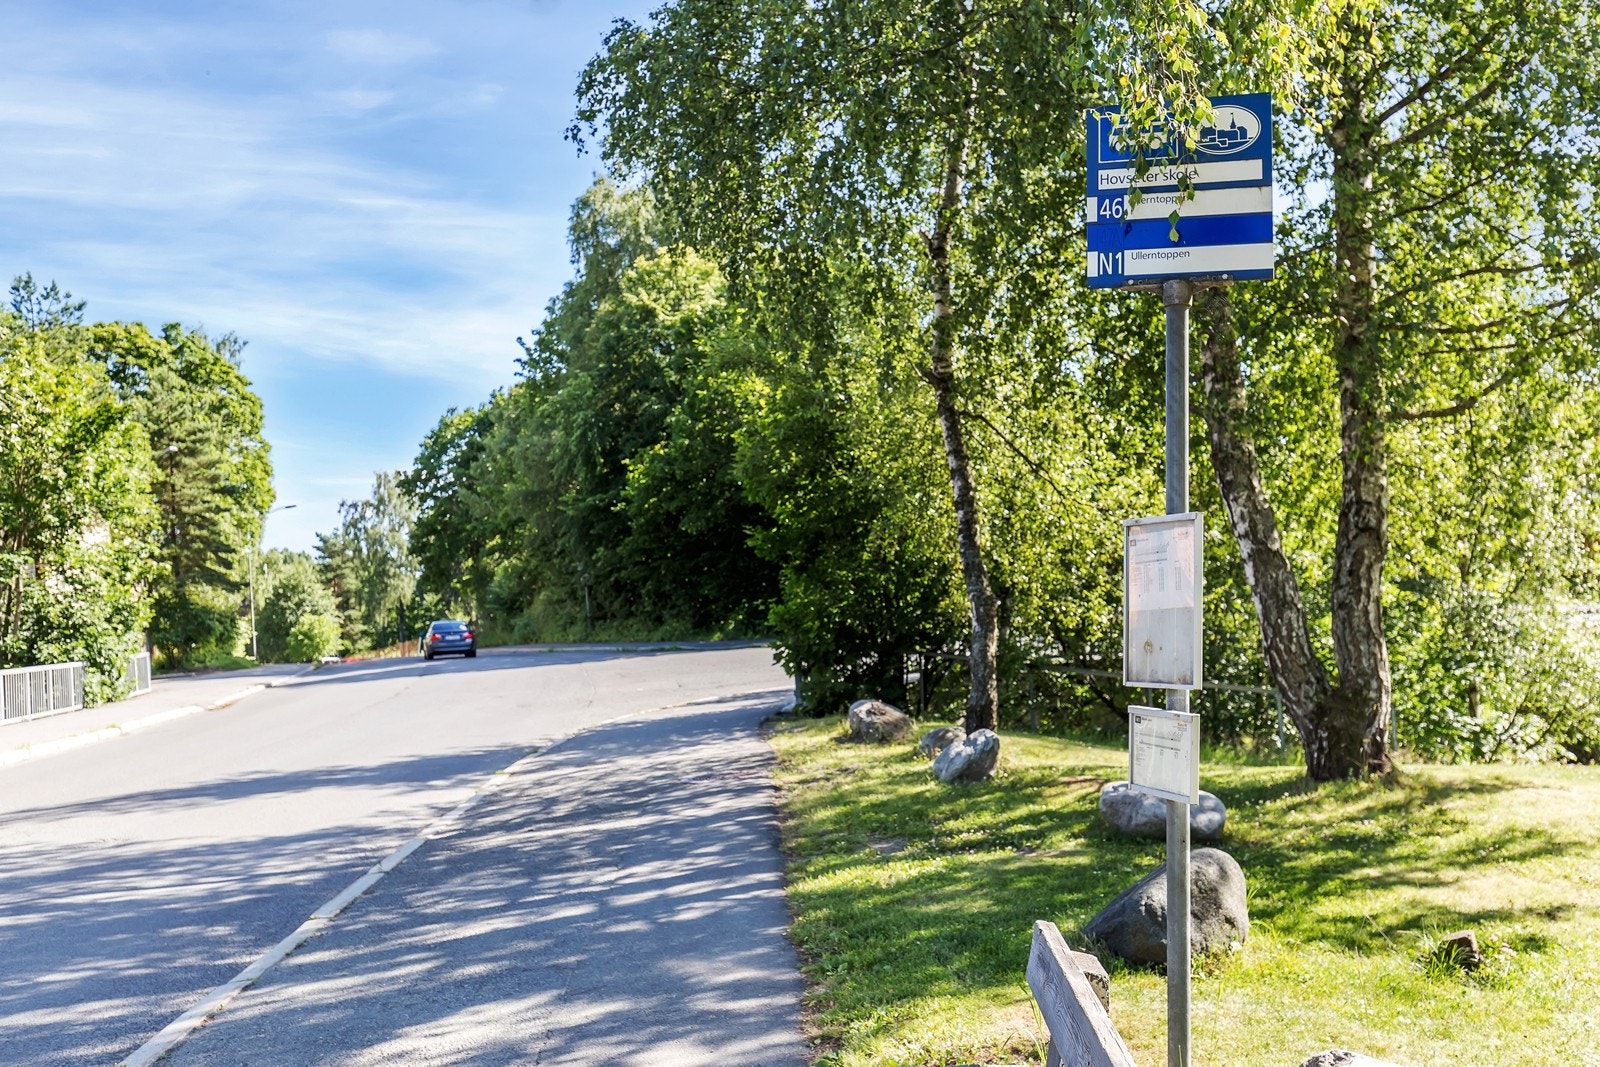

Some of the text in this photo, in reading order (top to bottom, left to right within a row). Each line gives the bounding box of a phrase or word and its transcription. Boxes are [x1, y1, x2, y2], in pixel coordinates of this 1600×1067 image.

[1099, 197, 1123, 219] 46
[1099, 252, 1122, 275] N1
[1131, 250, 1190, 261] Ullerntoppen
